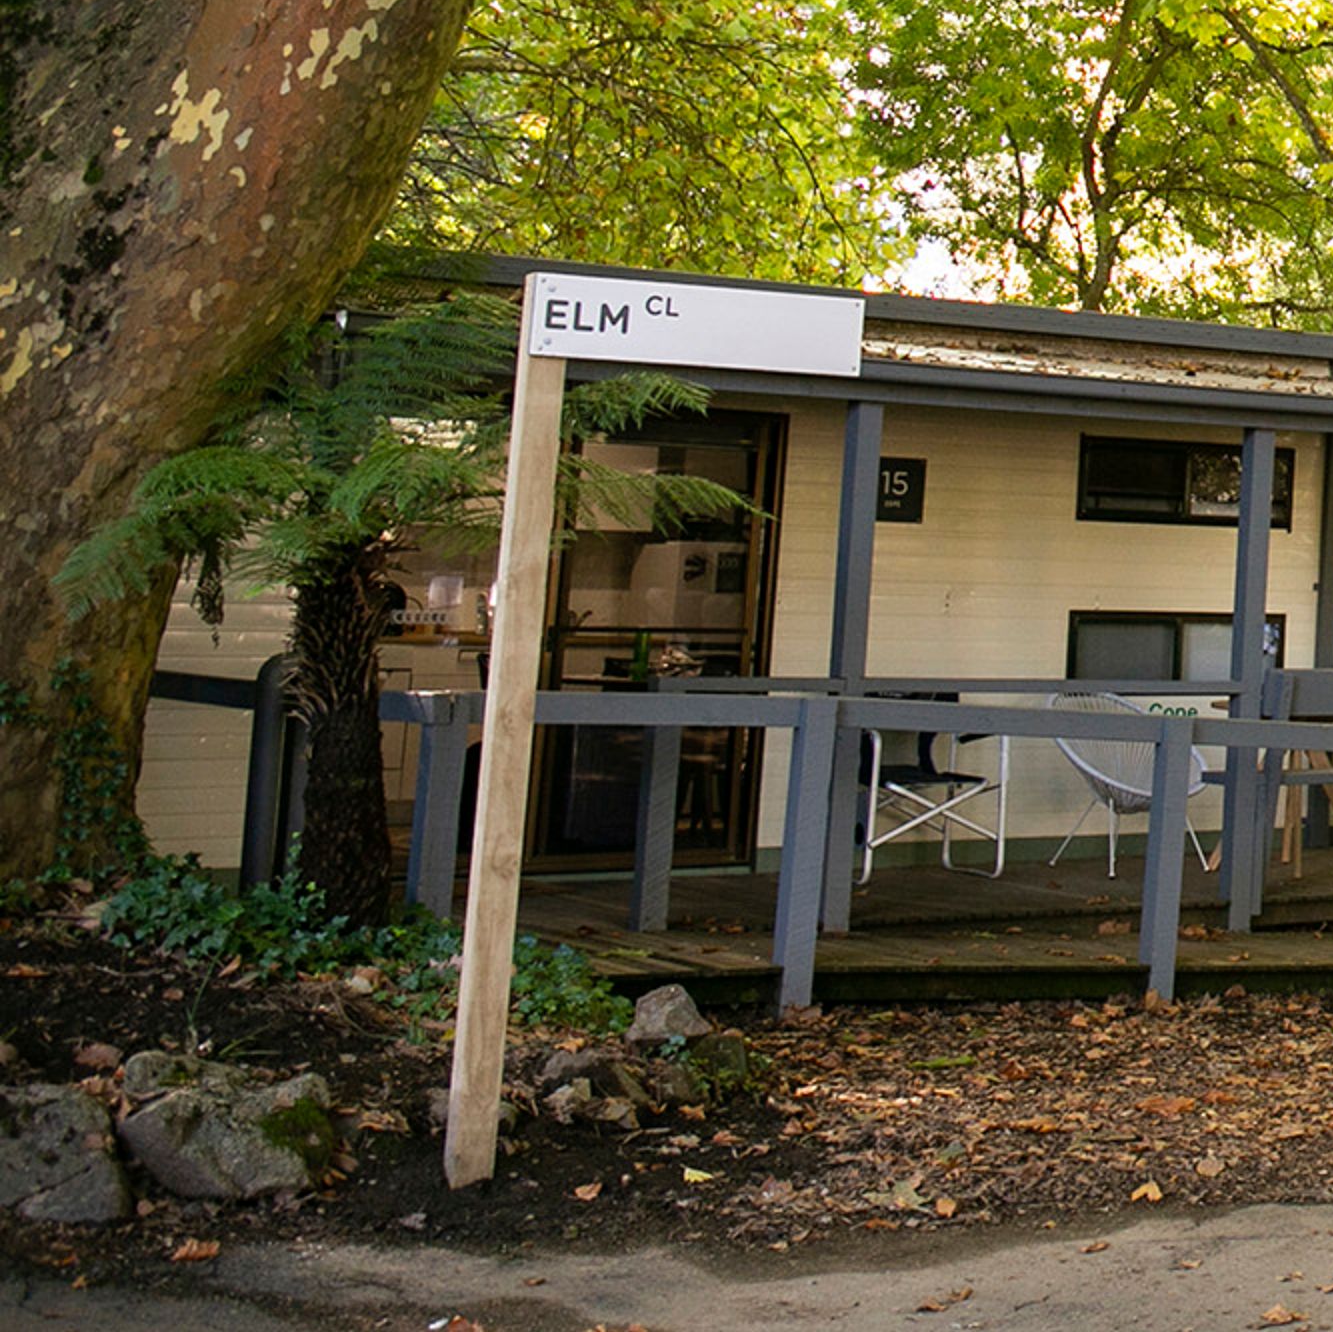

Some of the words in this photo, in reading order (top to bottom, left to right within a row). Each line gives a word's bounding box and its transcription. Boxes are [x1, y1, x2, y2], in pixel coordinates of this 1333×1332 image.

[545, 299, 630, 334] ELM
[645, 295, 679, 317] CL
[881, 471, 908, 495] 15
